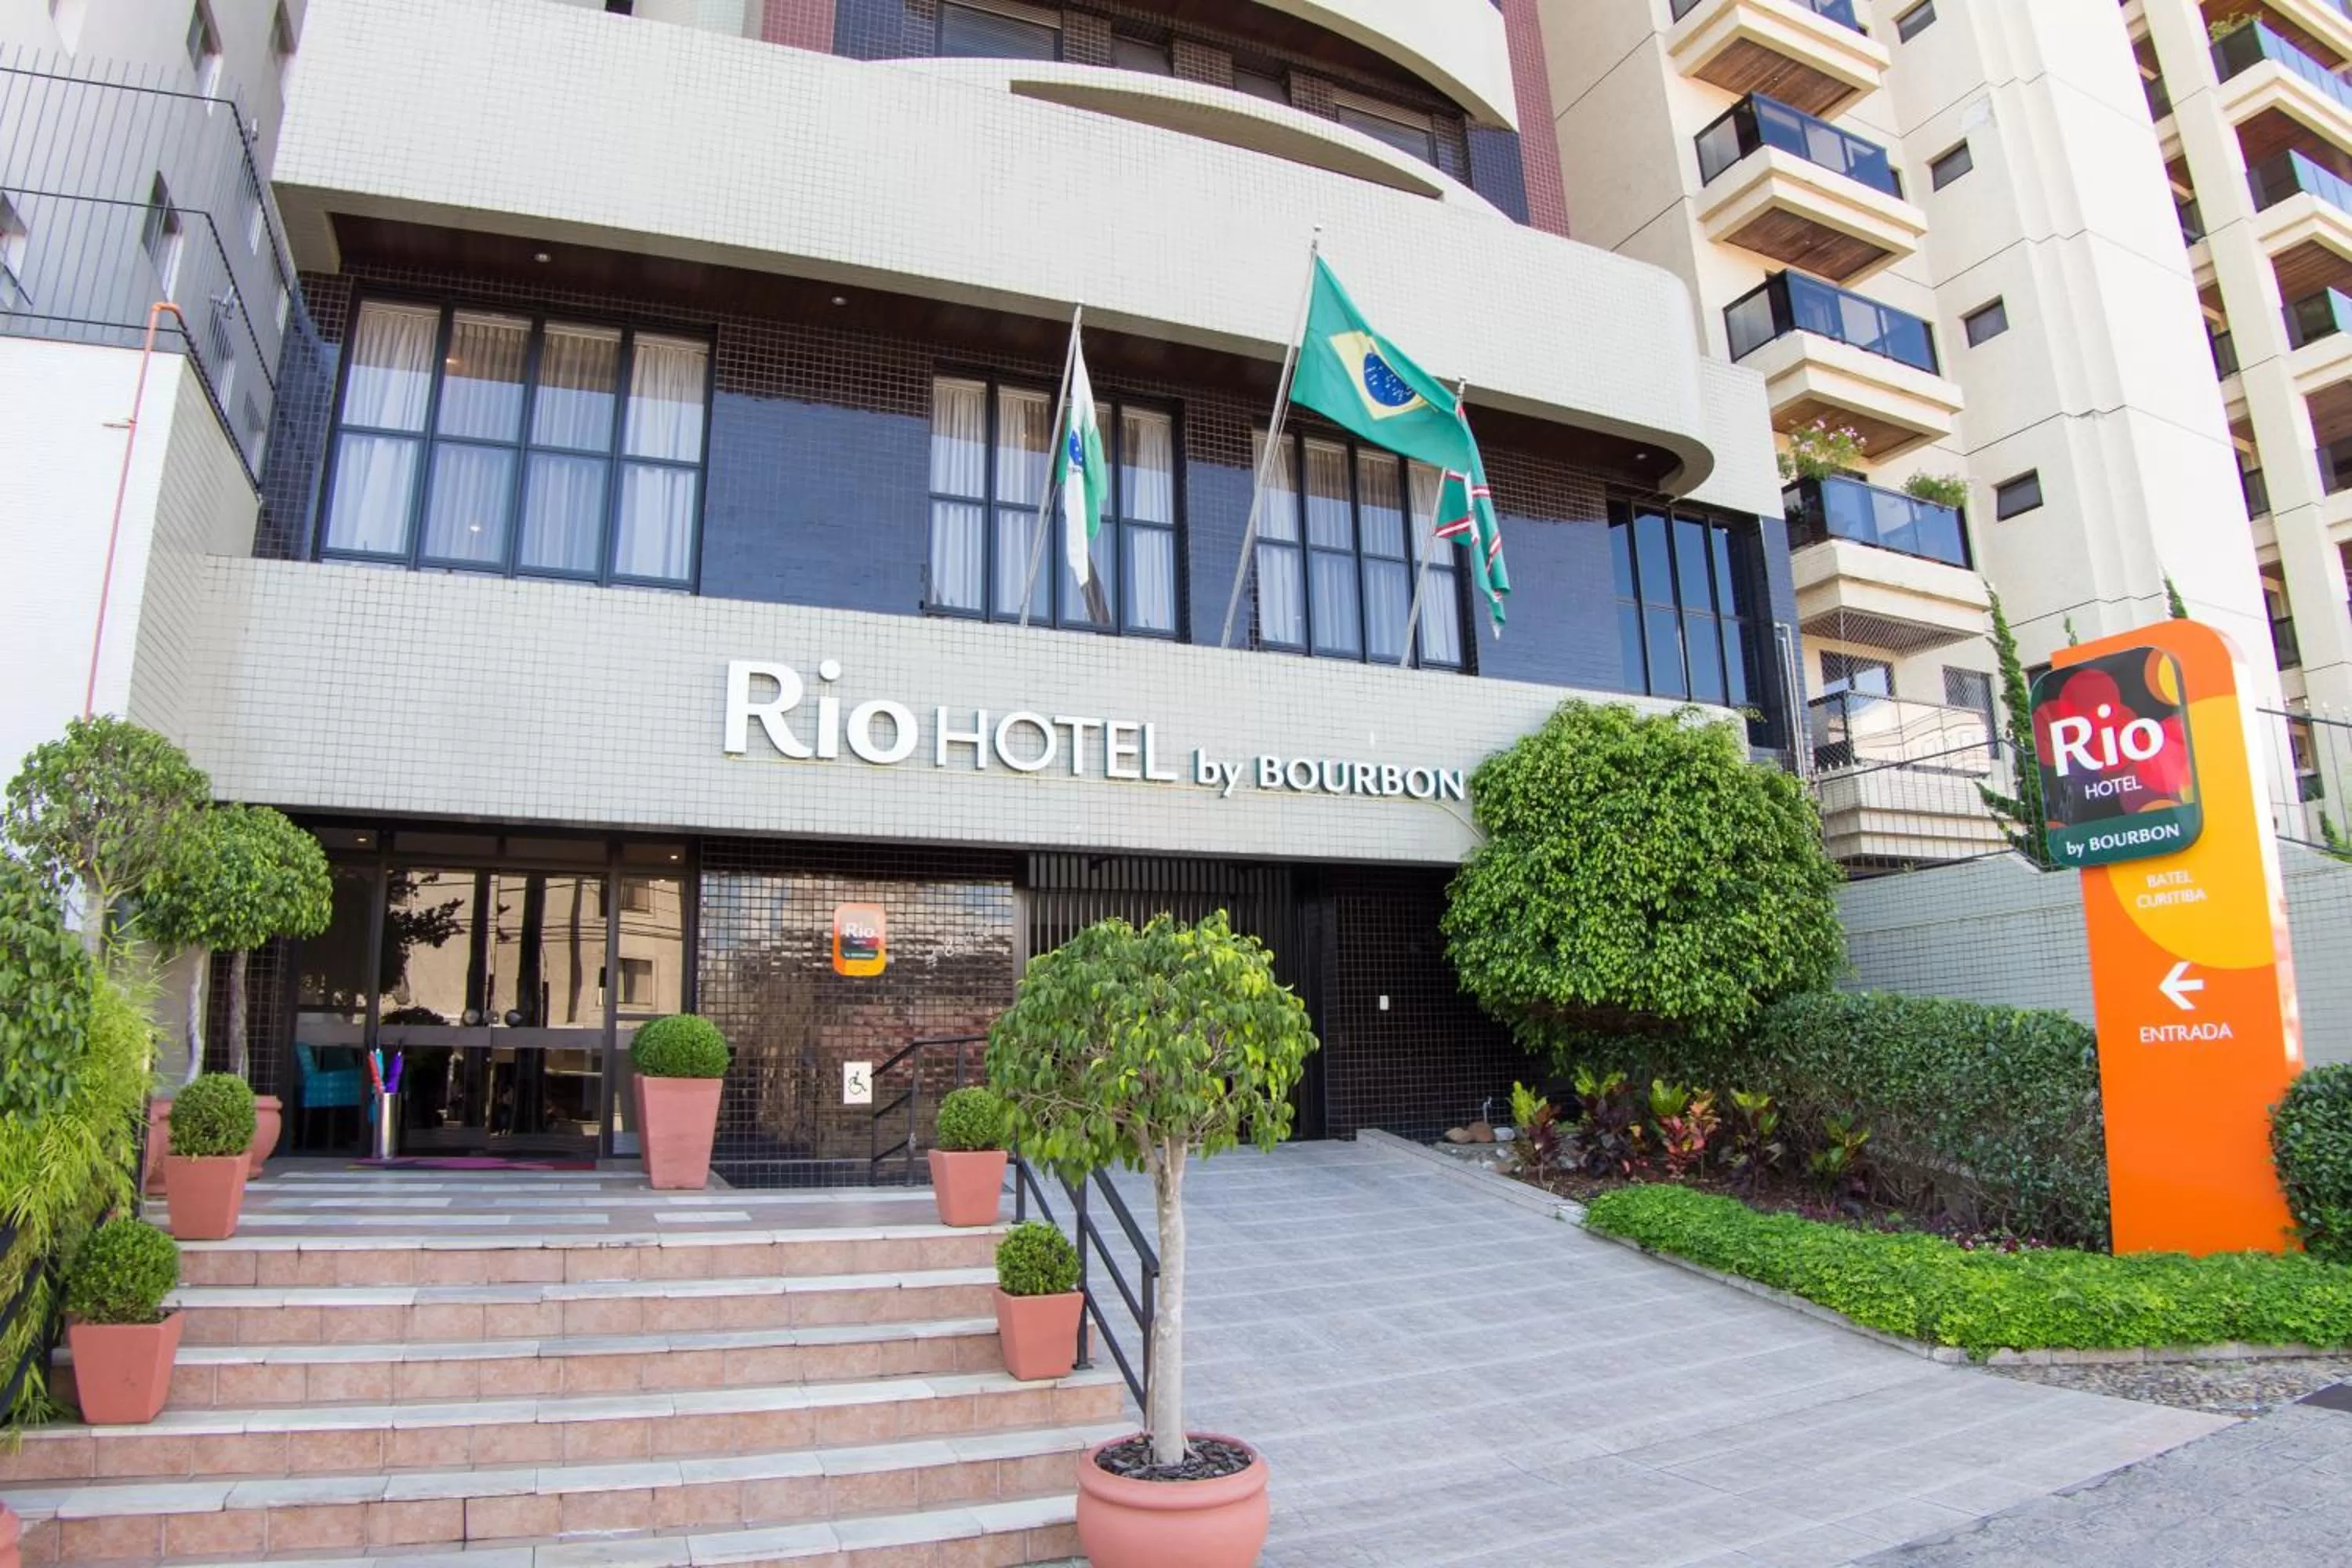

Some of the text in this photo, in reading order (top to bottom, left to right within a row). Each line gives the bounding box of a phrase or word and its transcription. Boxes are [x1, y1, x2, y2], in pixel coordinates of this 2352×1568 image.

[724, 659, 1466, 800] Rio HOTEL by BOURBON
[2049, 704, 2165, 777] Rio
[2085, 775, 2143, 800] HOTEL
[2066, 823, 2180, 858] by BOURBON
[2146, 869, 2193, 888] BATEL
[2136, 887, 2208, 908] CURITIBA
[846, 920, 876, 938] Rio
[2139, 1022, 2234, 1043] ENTRADA
